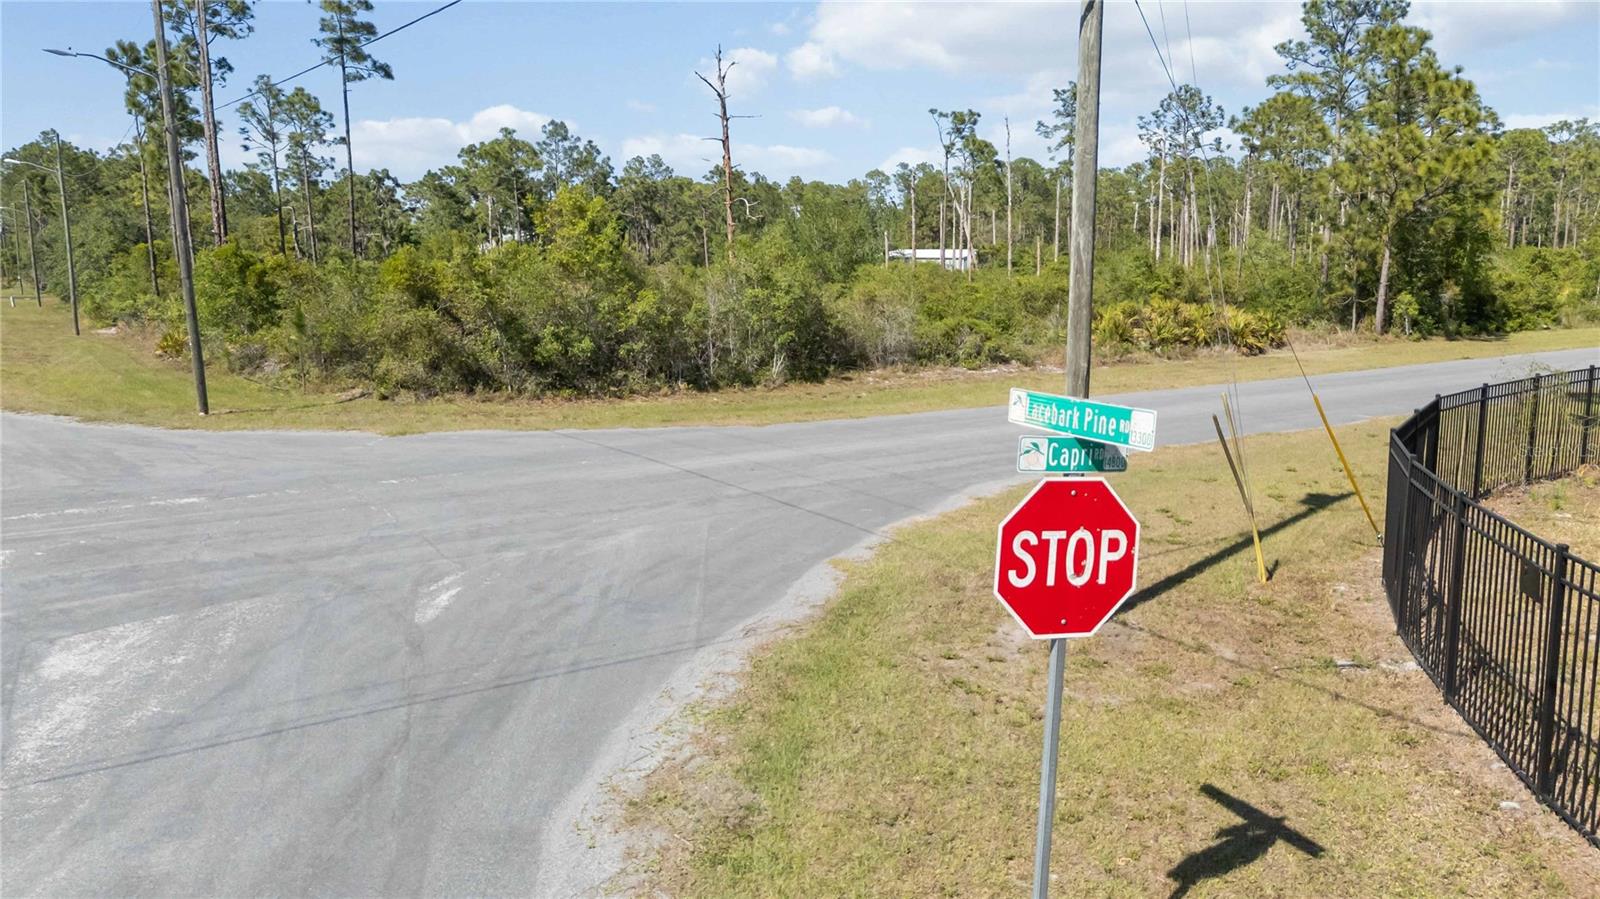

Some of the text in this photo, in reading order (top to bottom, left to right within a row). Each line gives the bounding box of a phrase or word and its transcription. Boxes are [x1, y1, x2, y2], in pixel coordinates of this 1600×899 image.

[1027, 397, 1130, 436] Lacebark Pine RD
[1049, 442, 1105, 470] Capri RD
[1007, 528, 1129, 588] STOP
